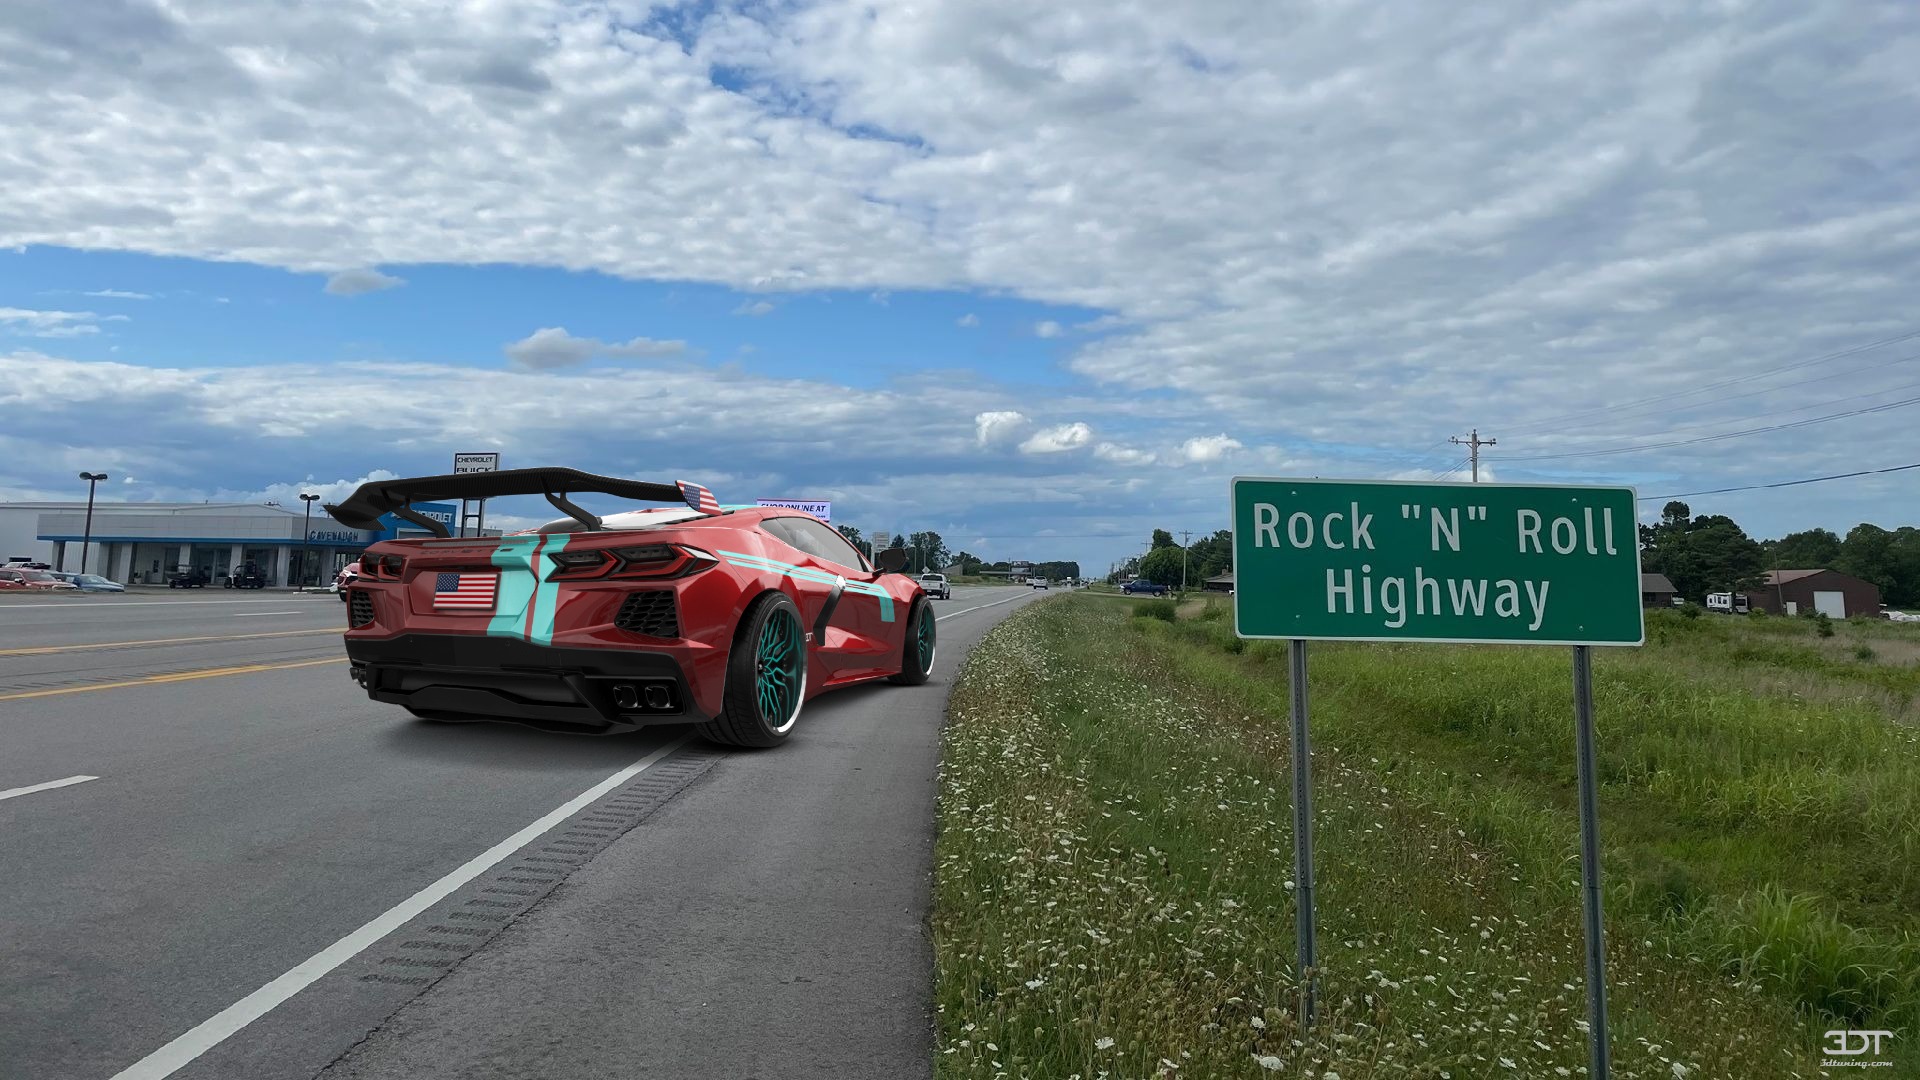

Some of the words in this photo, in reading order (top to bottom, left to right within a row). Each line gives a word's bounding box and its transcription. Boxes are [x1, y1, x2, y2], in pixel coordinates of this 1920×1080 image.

[1253, 501, 1376, 550] Rock
[1401, 504, 1488, 552] "N"
[1517, 507, 1618, 556] Roll
[1326, 563, 1550, 632] Highway
